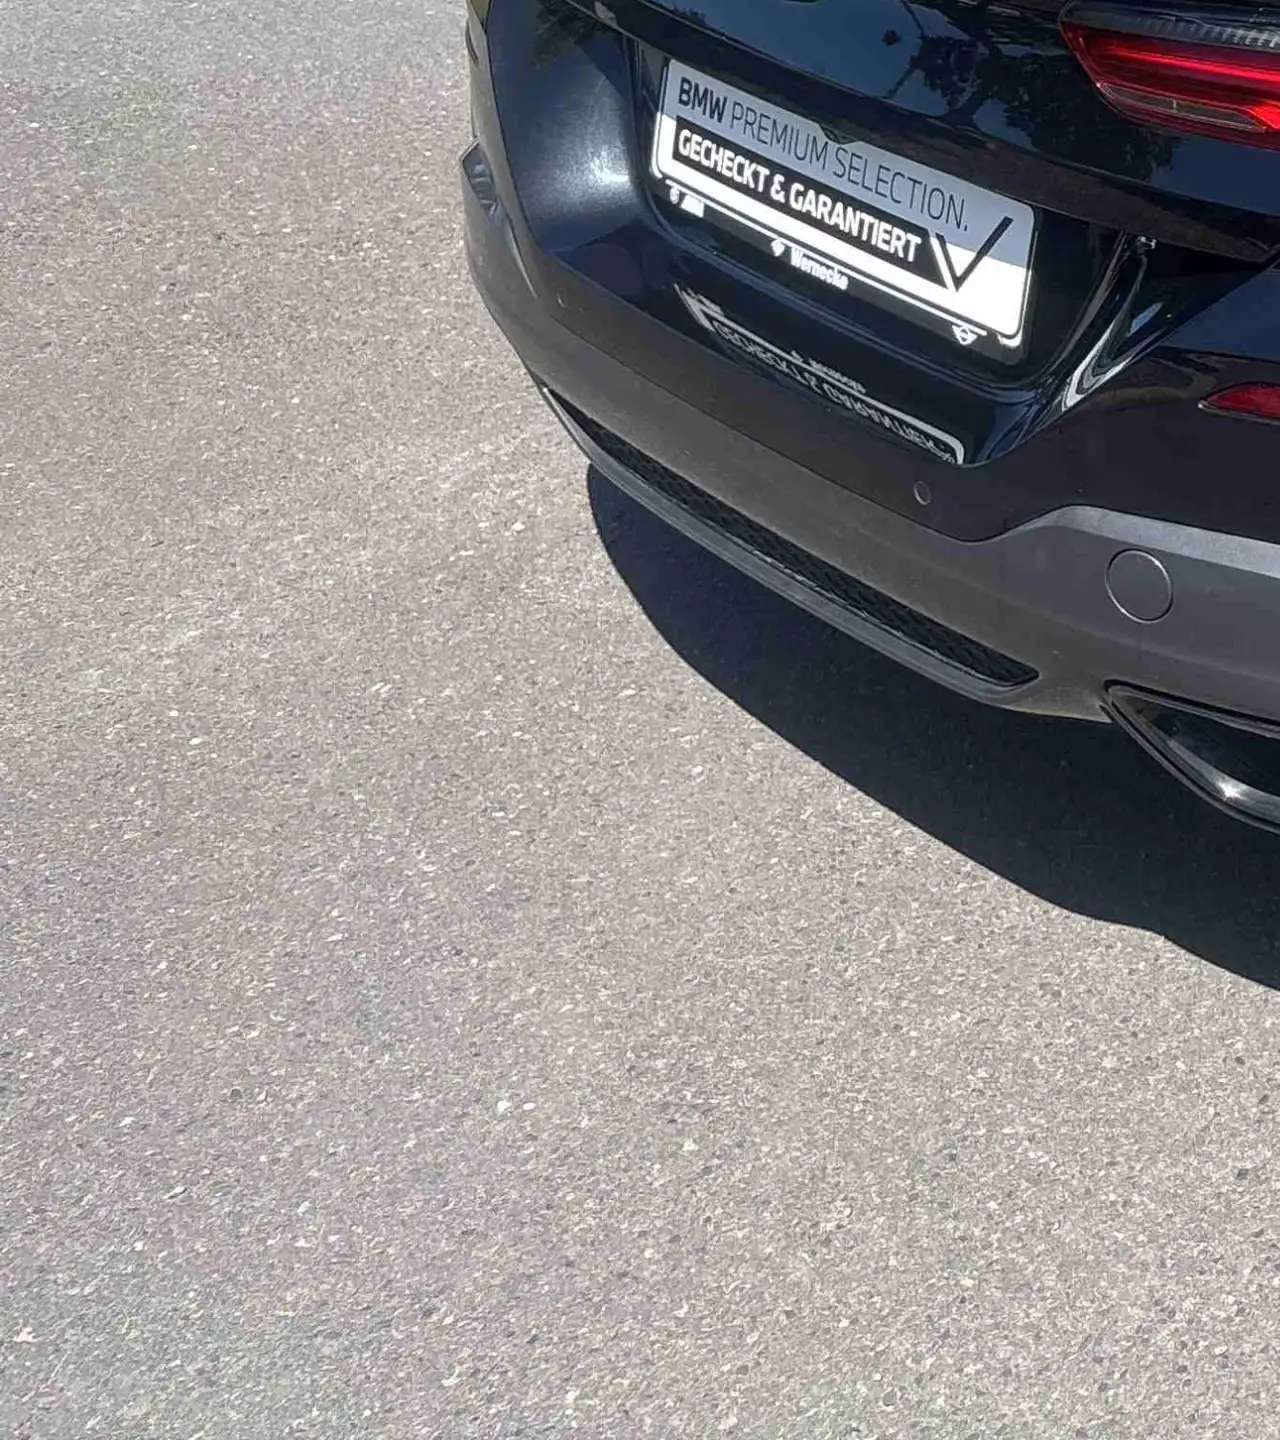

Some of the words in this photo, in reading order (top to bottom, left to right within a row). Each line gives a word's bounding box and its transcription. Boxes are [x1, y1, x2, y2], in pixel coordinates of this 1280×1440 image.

[678, 76, 728, 123] BMW
[730, 100, 829, 172] PREMIUM
[832, 147, 968, 232] SELECTION.
[678, 129, 770, 193] GECHECKT
[770, 173, 786, 203] &
[789, 182, 922, 262] GARANTIERT
[789, 247, 849, 291] Wernecke
